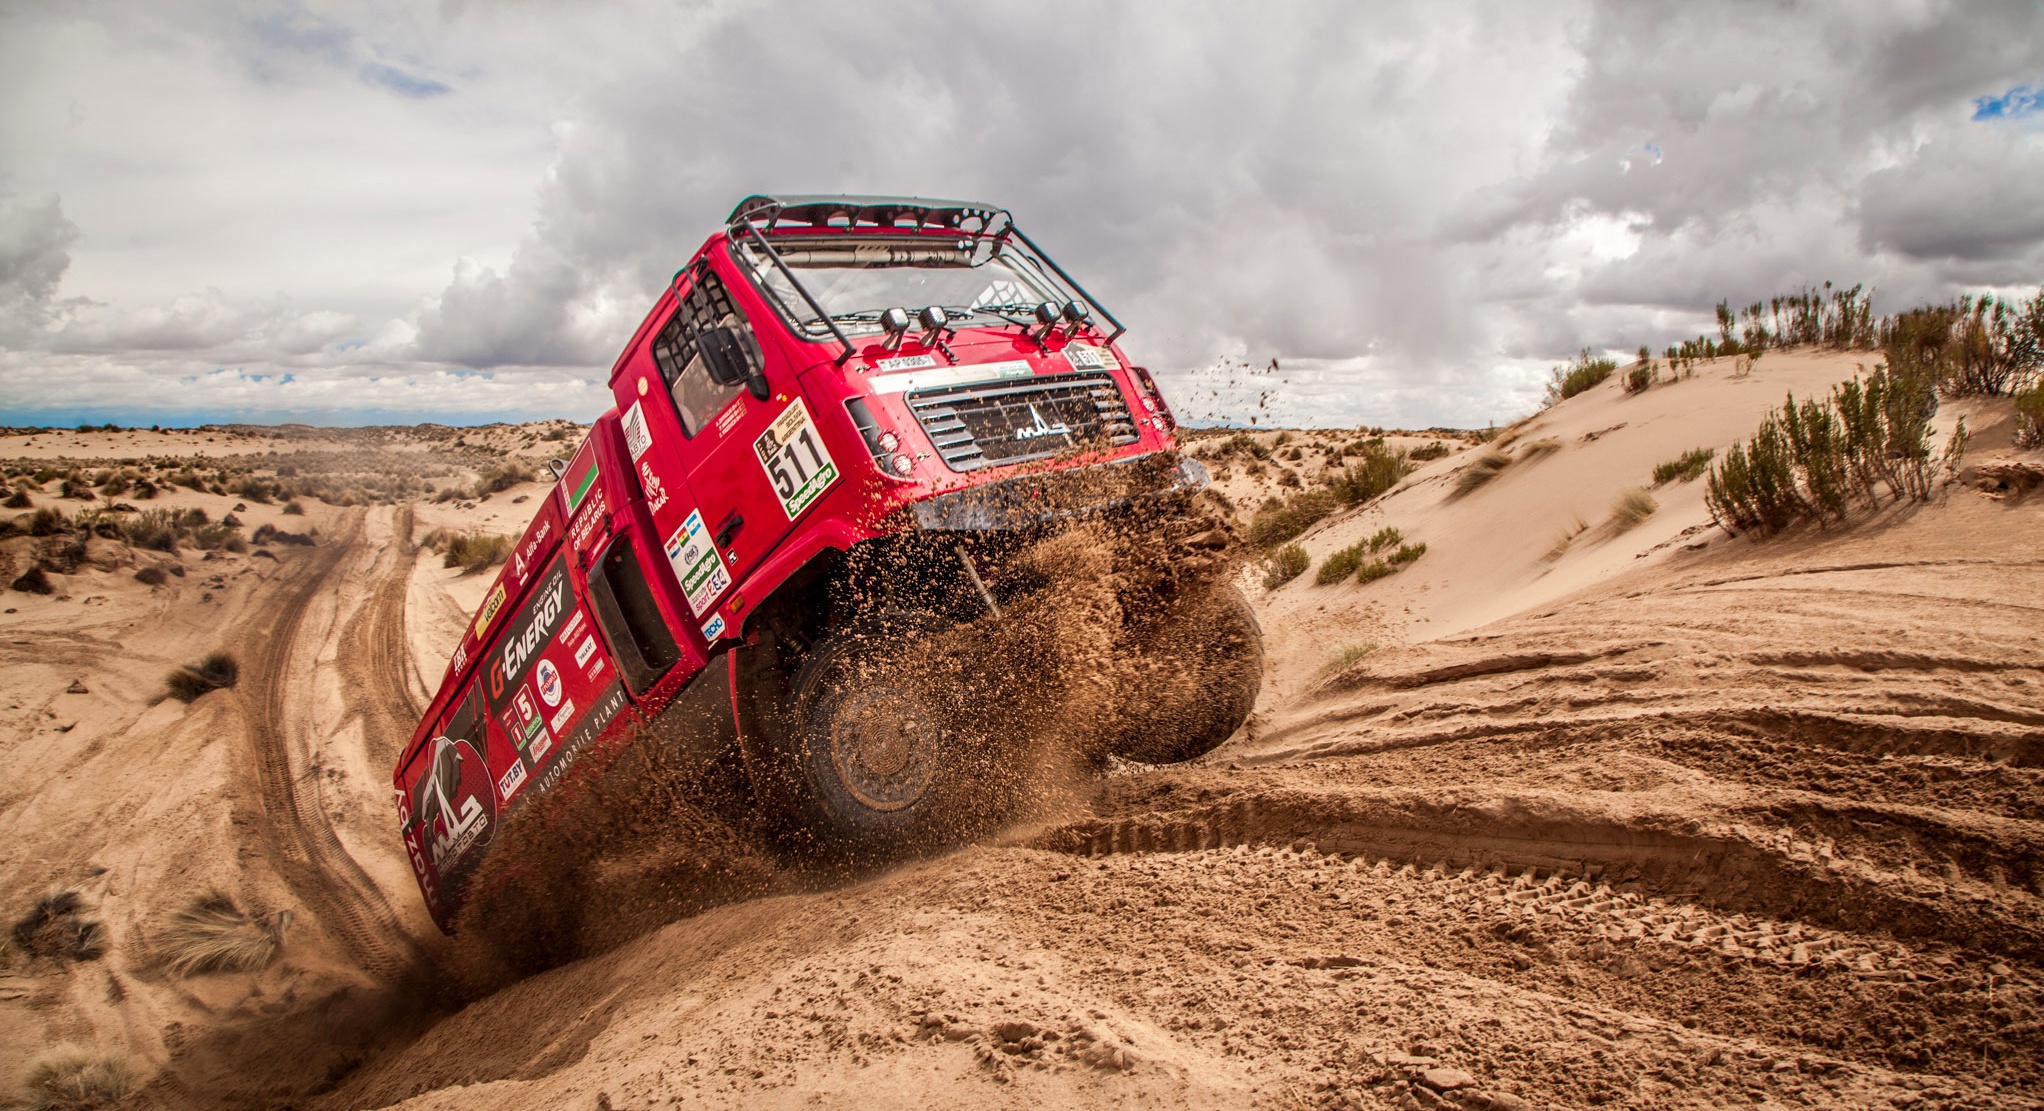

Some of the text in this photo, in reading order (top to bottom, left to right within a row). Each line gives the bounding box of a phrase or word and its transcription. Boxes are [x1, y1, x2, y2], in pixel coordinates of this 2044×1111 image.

[767, 427, 824, 500] 511
[788, 467, 833, 513] SpeedAgro
[570, 488, 603, 539] REPUBLIC
[573, 501, 606, 550] OF BELARUS
[532, 569, 563, 615] ENGINE OIL
[684, 554, 716, 591] SpeedAgro
[483, 589, 505, 623] velcom
[695, 592, 711, 611] sport
[517, 693, 533, 721] 5
[594, 690, 624, 730] PLANT
[500, 762, 523, 793] TUT.BY
